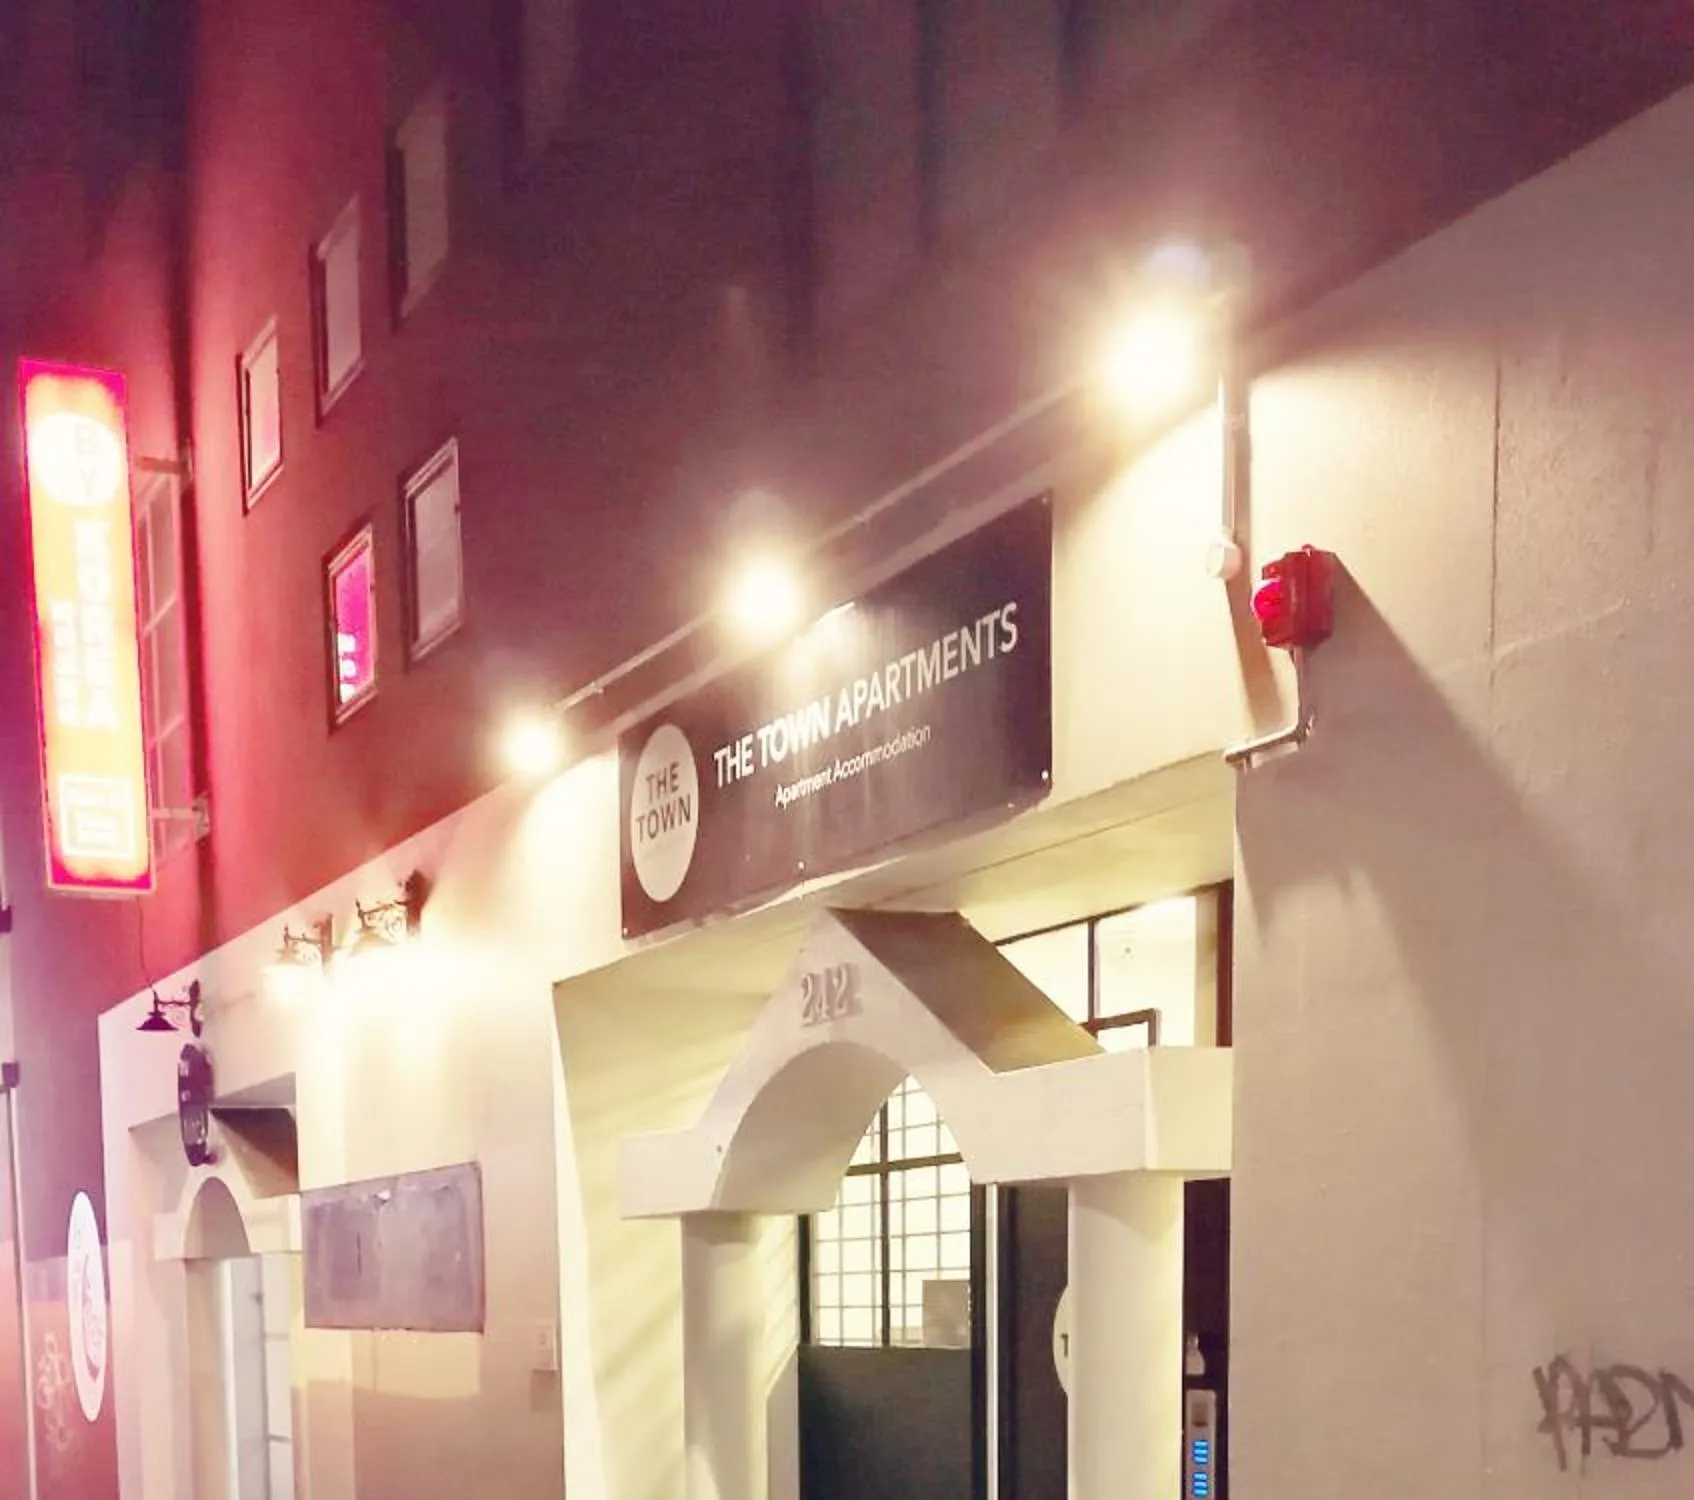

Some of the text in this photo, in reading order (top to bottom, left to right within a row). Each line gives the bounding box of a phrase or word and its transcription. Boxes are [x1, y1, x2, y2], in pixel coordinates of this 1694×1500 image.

[713, 602, 1018, 788] THE TOWN APARTMENTS
[646, 761, 679, 804] THE
[775, 725, 931, 809] Apartment Accommodation
[635, 793, 691, 842] TOWN
